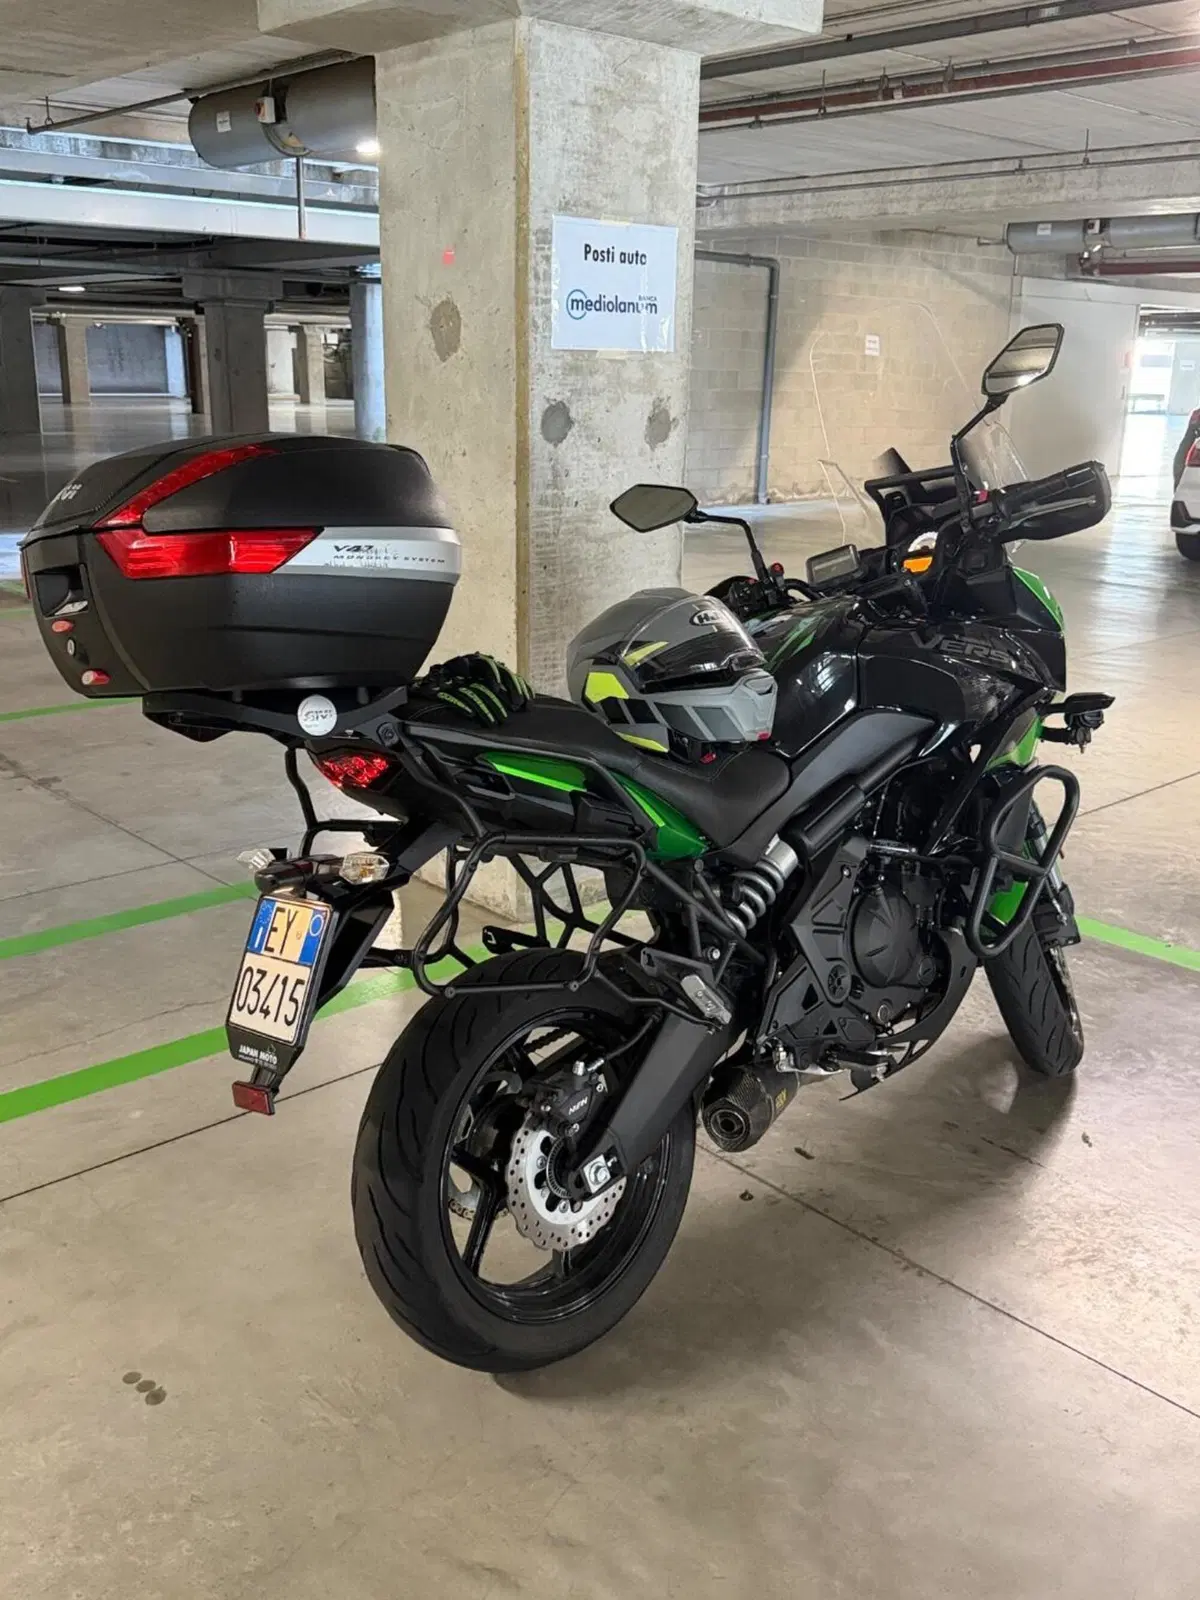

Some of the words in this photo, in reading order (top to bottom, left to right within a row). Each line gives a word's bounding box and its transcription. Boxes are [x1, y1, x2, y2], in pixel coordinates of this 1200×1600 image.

[583, 243, 615, 263] Posti
[619, 250, 648, 265] auto
[570, 293, 658, 314] mediolanum
[264, 906, 299, 956] EY
[236, 966, 306, 1027] 03415
[239, 1045, 259, 1058] JAPAN
[259, 1050, 278, 1065] MOTO
